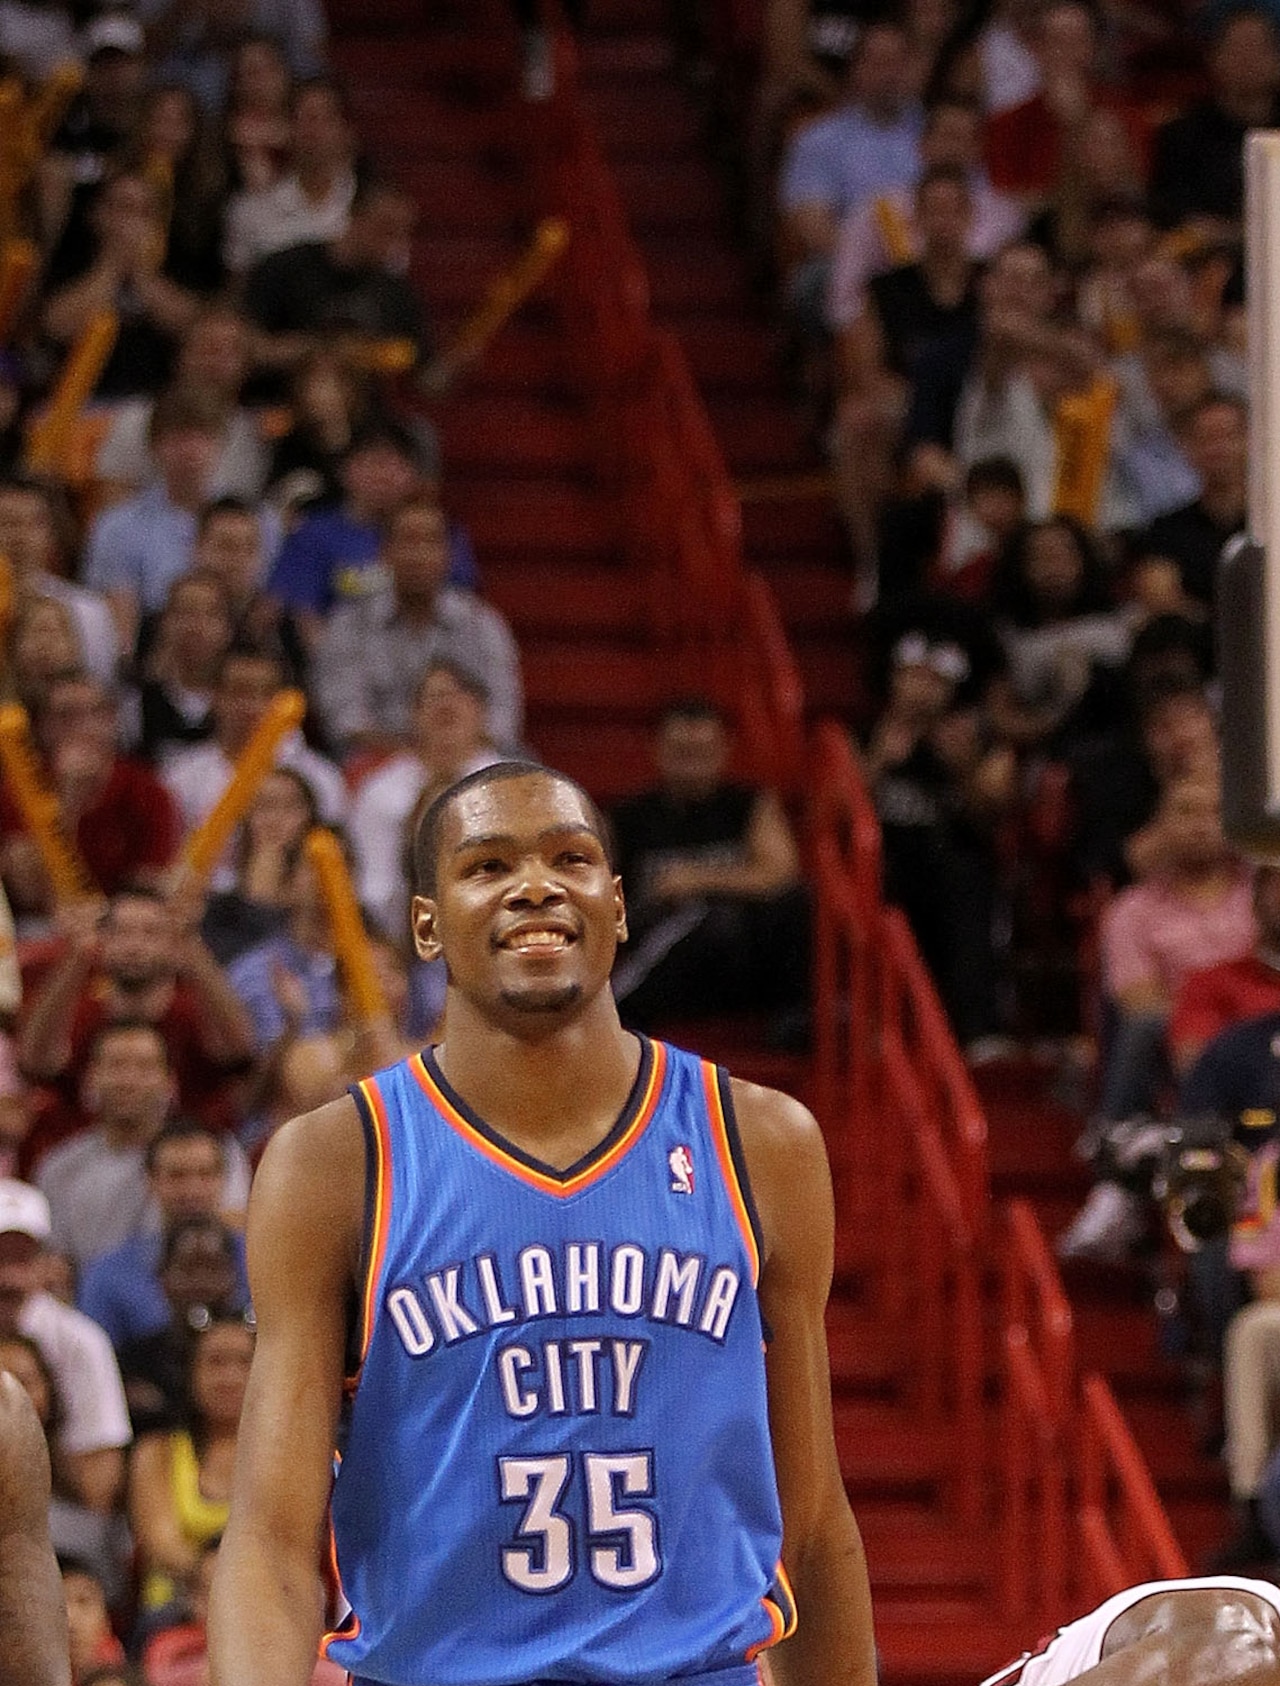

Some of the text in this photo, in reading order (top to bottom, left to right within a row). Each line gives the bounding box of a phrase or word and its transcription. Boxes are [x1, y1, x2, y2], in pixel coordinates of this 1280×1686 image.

[386, 1243, 742, 1361] OKLAHOMA
[499, 1338, 650, 1420] CITY
[499, 1449, 664, 1594] 35
